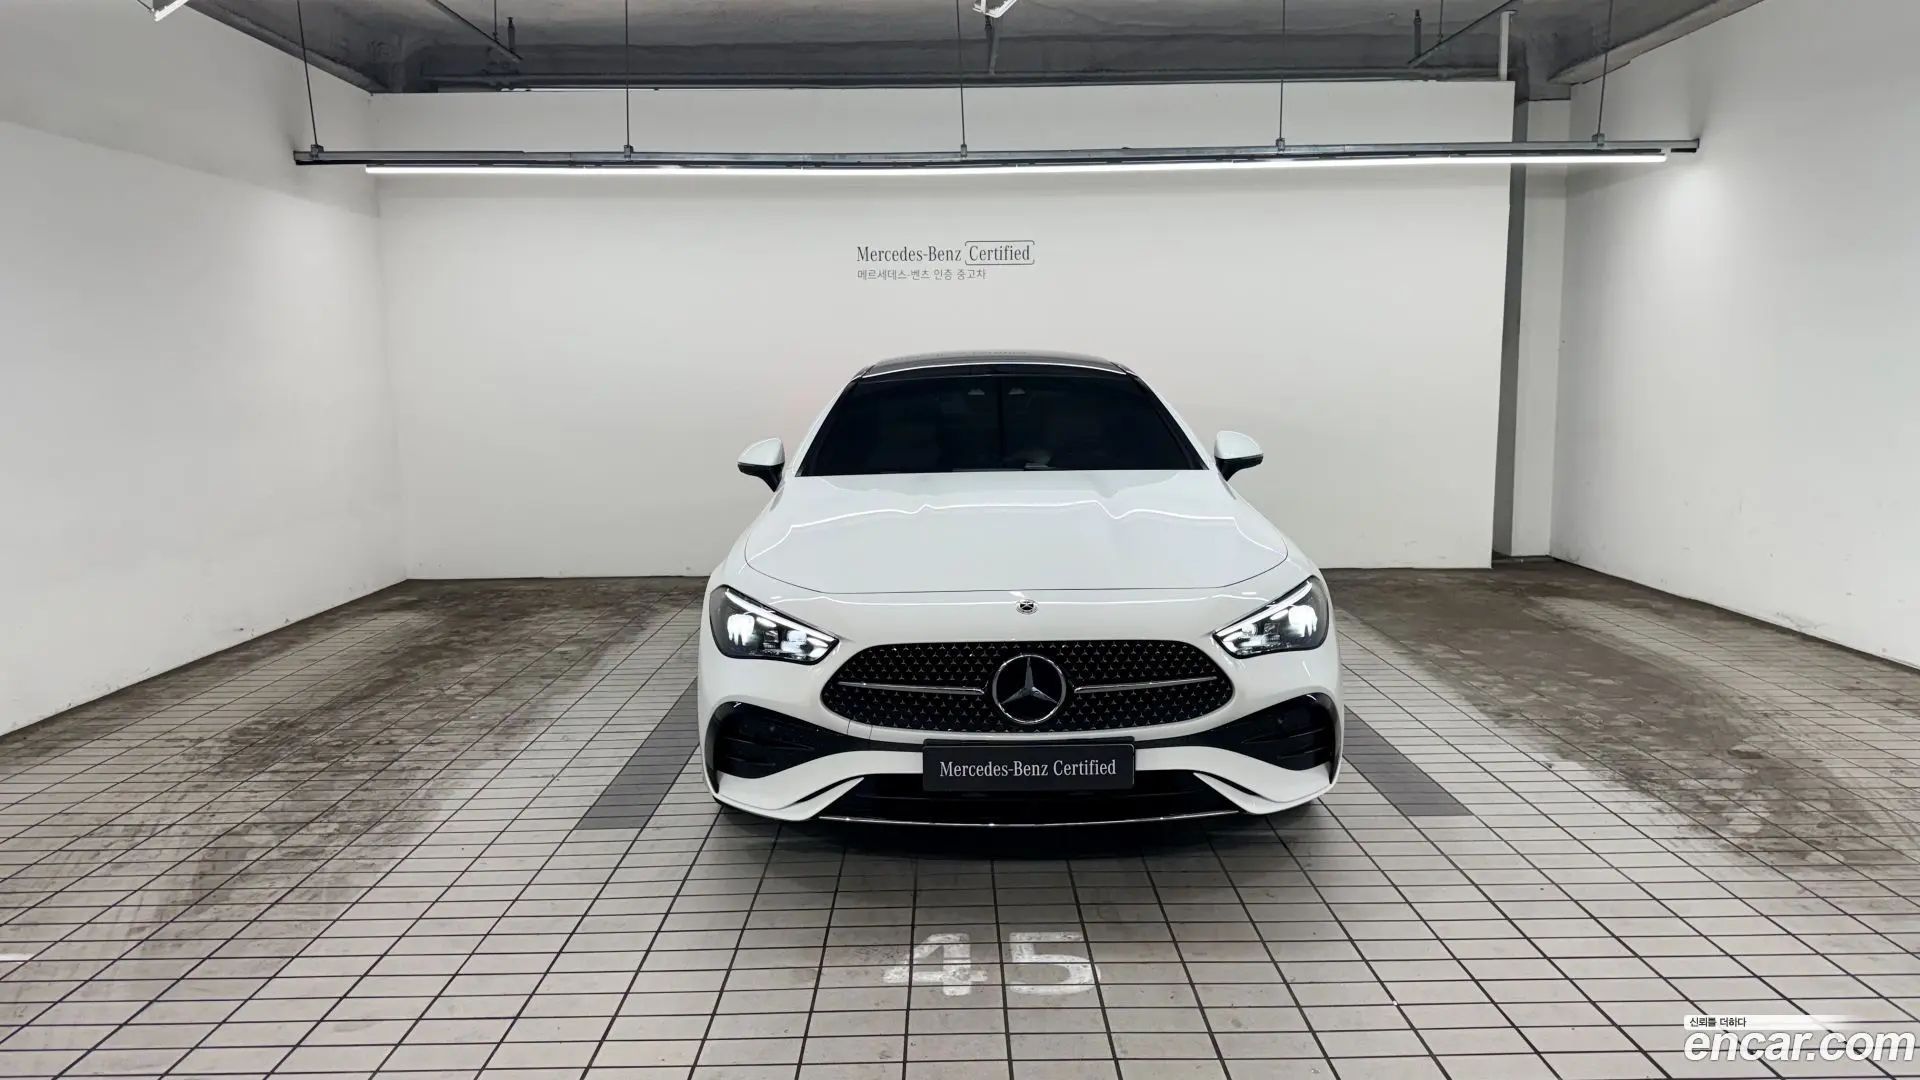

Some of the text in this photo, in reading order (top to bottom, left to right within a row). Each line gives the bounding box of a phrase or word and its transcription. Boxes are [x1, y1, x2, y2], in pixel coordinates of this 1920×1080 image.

[857, 245, 1030, 262] Mercedes-Benz Certified
[934, 269, 952, 280] 인증
[957, 269, 986, 280] 중고차
[940, 759, 1116, 777] Mercedes-Benz Certified
[882, 932, 1101, 996] 45
